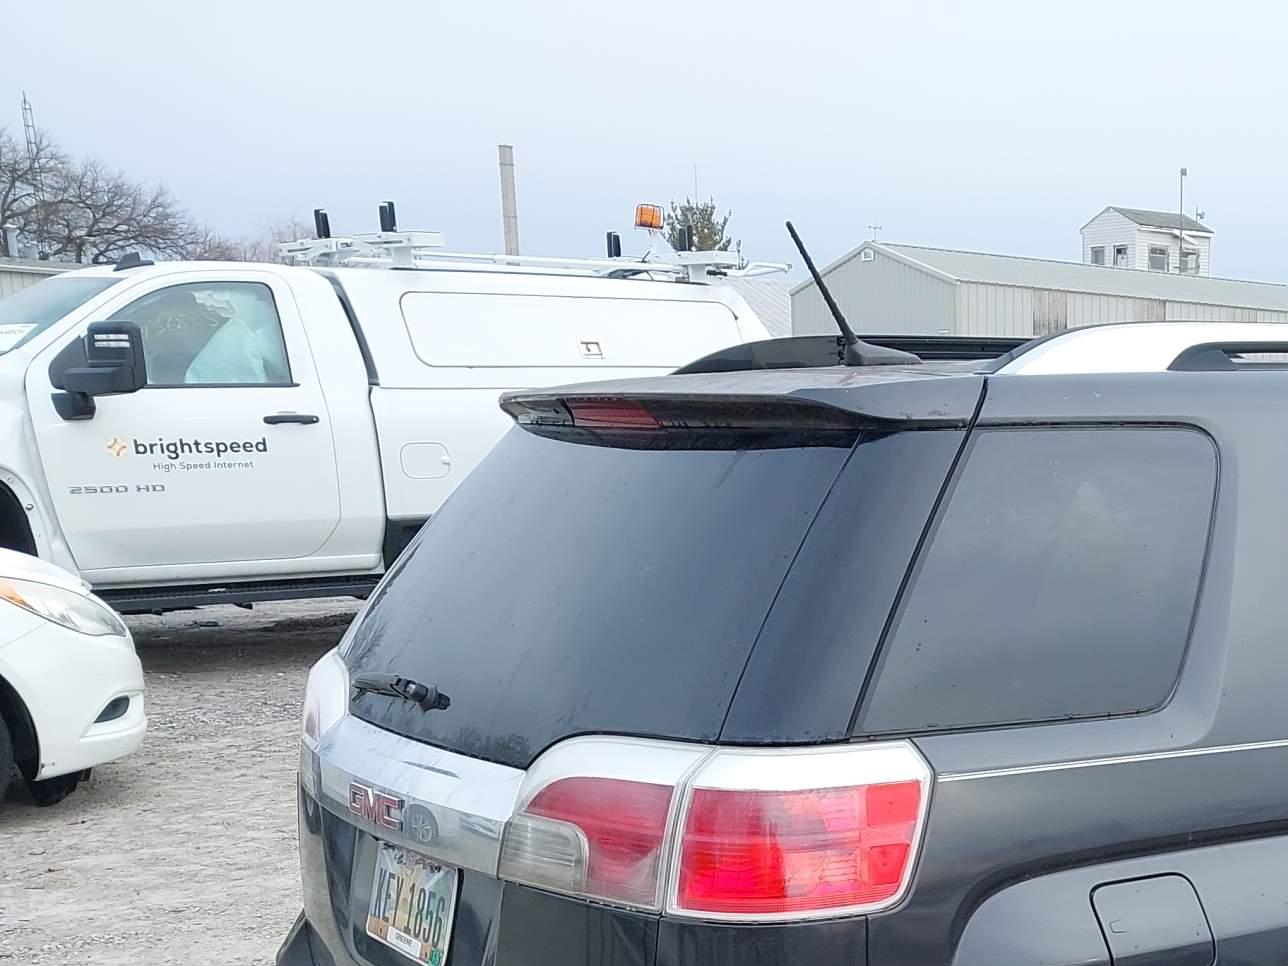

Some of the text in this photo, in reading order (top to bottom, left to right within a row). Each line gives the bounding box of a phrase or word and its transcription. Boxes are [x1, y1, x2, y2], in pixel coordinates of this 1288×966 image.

[133, 437, 268, 460] brightspeed
[152, 460, 255, 473] High Speed Internet
[69, 484, 166, 494] 2500 HD
[348, 781, 402, 831] GMC
[404, 883, 446, 948] 1856
